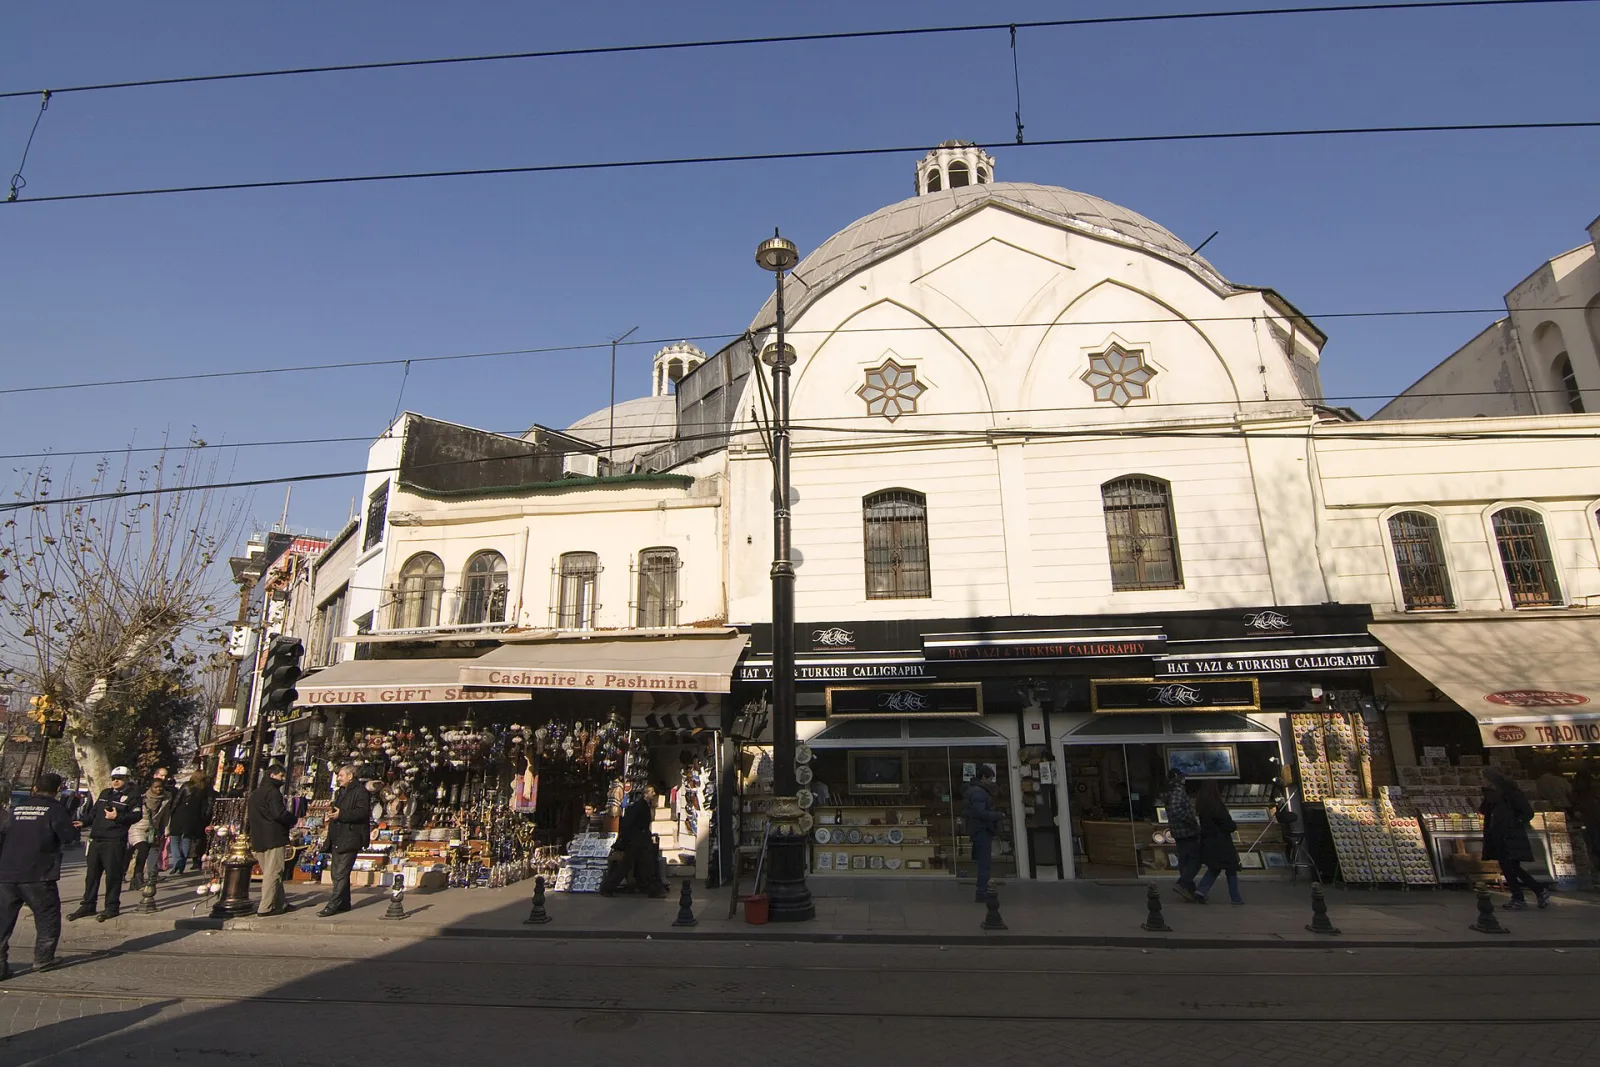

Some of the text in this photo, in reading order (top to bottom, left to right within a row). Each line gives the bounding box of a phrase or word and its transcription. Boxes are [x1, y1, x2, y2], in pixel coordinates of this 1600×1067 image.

[949, 643, 1145, 659] HAT YAZI & TURKISH CALLIGRAPHY
[1167, 654, 1375, 673] HAT YAZI & TURKISH CALLIGRAPHY
[740, 668, 760, 679] HAT
[801, 667, 848, 678] TURKISH
[853, 665, 925, 677] CALLIGRAPHY
[488, 671, 699, 690] Cashmire & Pashmina
[308, 689, 367, 704] UĞUR
